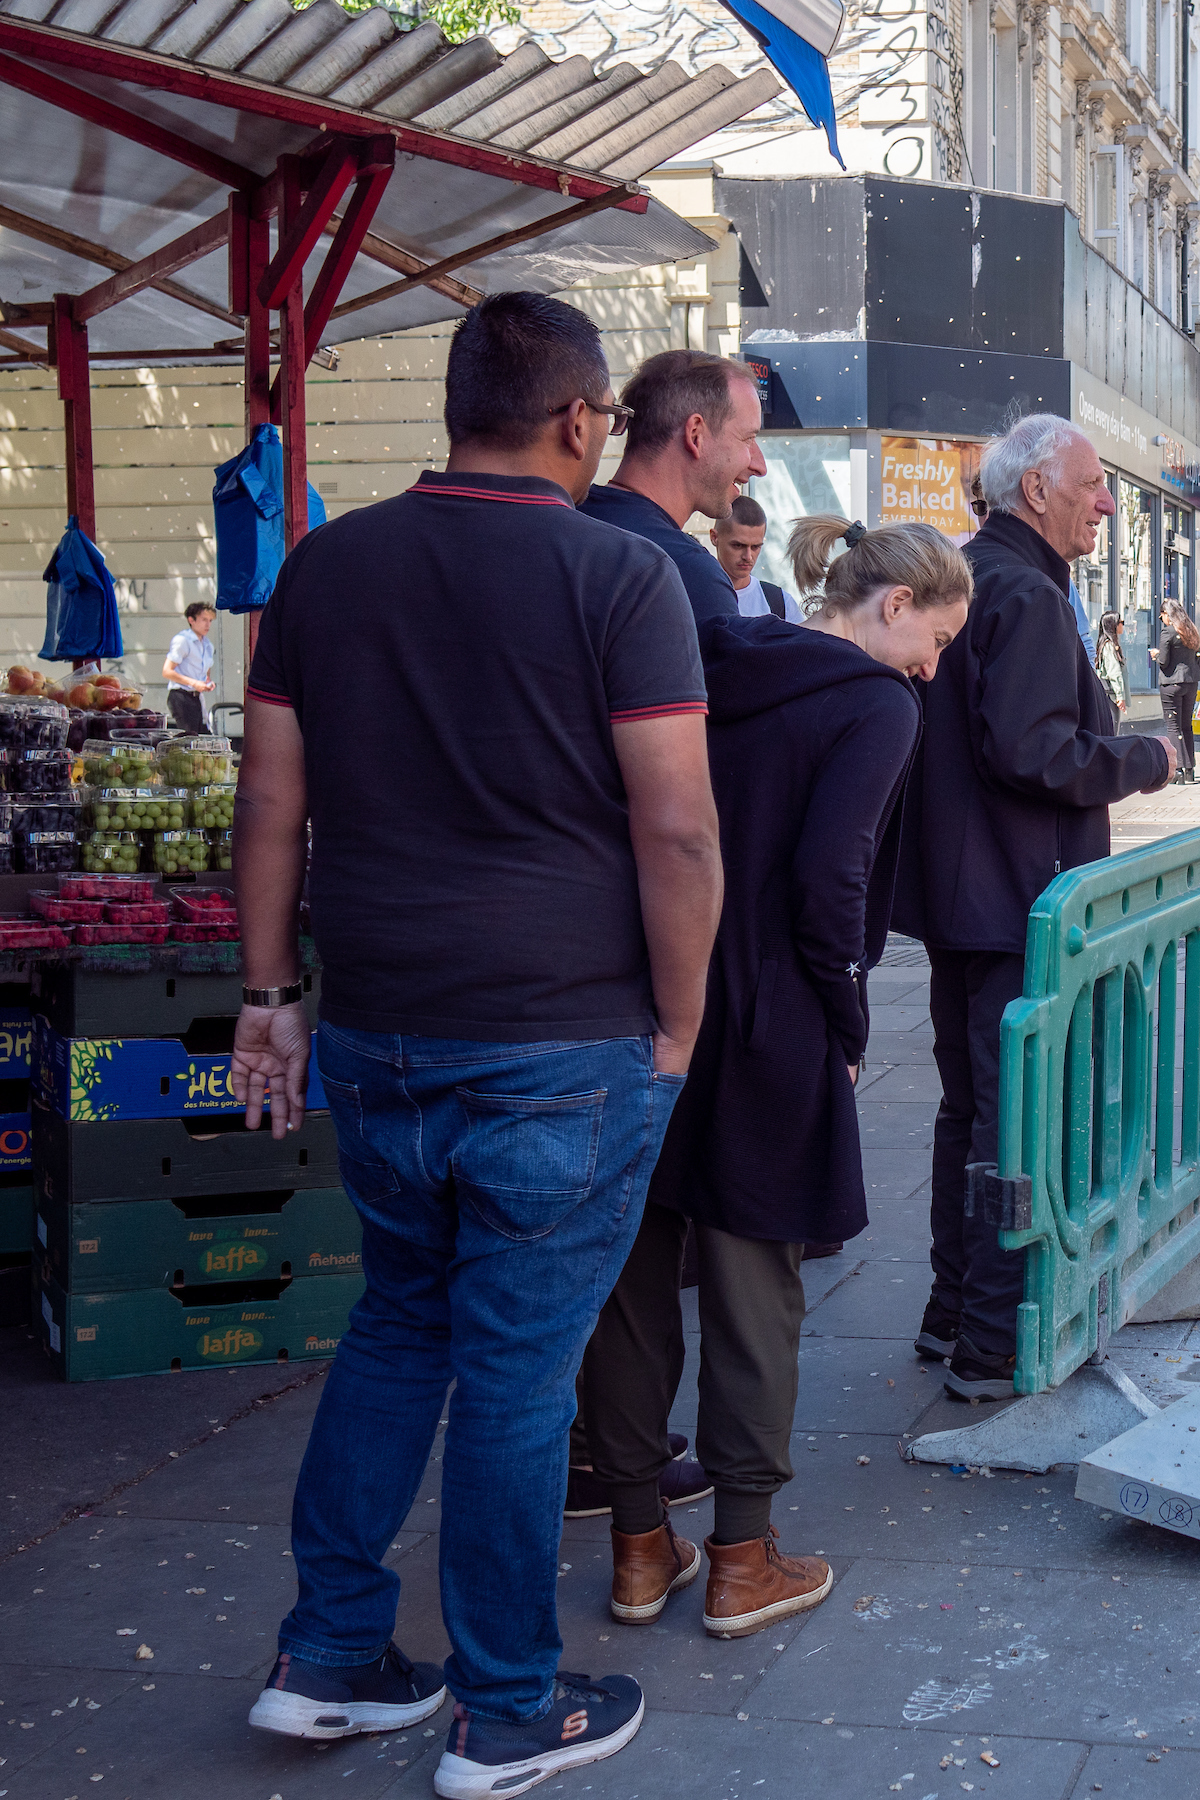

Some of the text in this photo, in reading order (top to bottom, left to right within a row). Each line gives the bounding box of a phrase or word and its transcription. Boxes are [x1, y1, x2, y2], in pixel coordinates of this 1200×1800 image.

[748, 362, 768, 378] ESCO
[1079, 391, 1094, 424] Open
[1095, 408, 1109, 437] every
[1110, 411, 1120, 442] day
[882, 456, 955, 487] Freshly
[882, 483, 954, 511] Baked
[929, 516, 954, 528] DAY
[188, 1231, 213, 1242] love
[205, 1246, 258, 1273] Jaffa
[309, 1252, 362, 1267] mehadr
[185, 1315, 210, 1326] love
[202, 1329, 255, 1356] Jaffa
[561, 1709, 588, 1740] S
